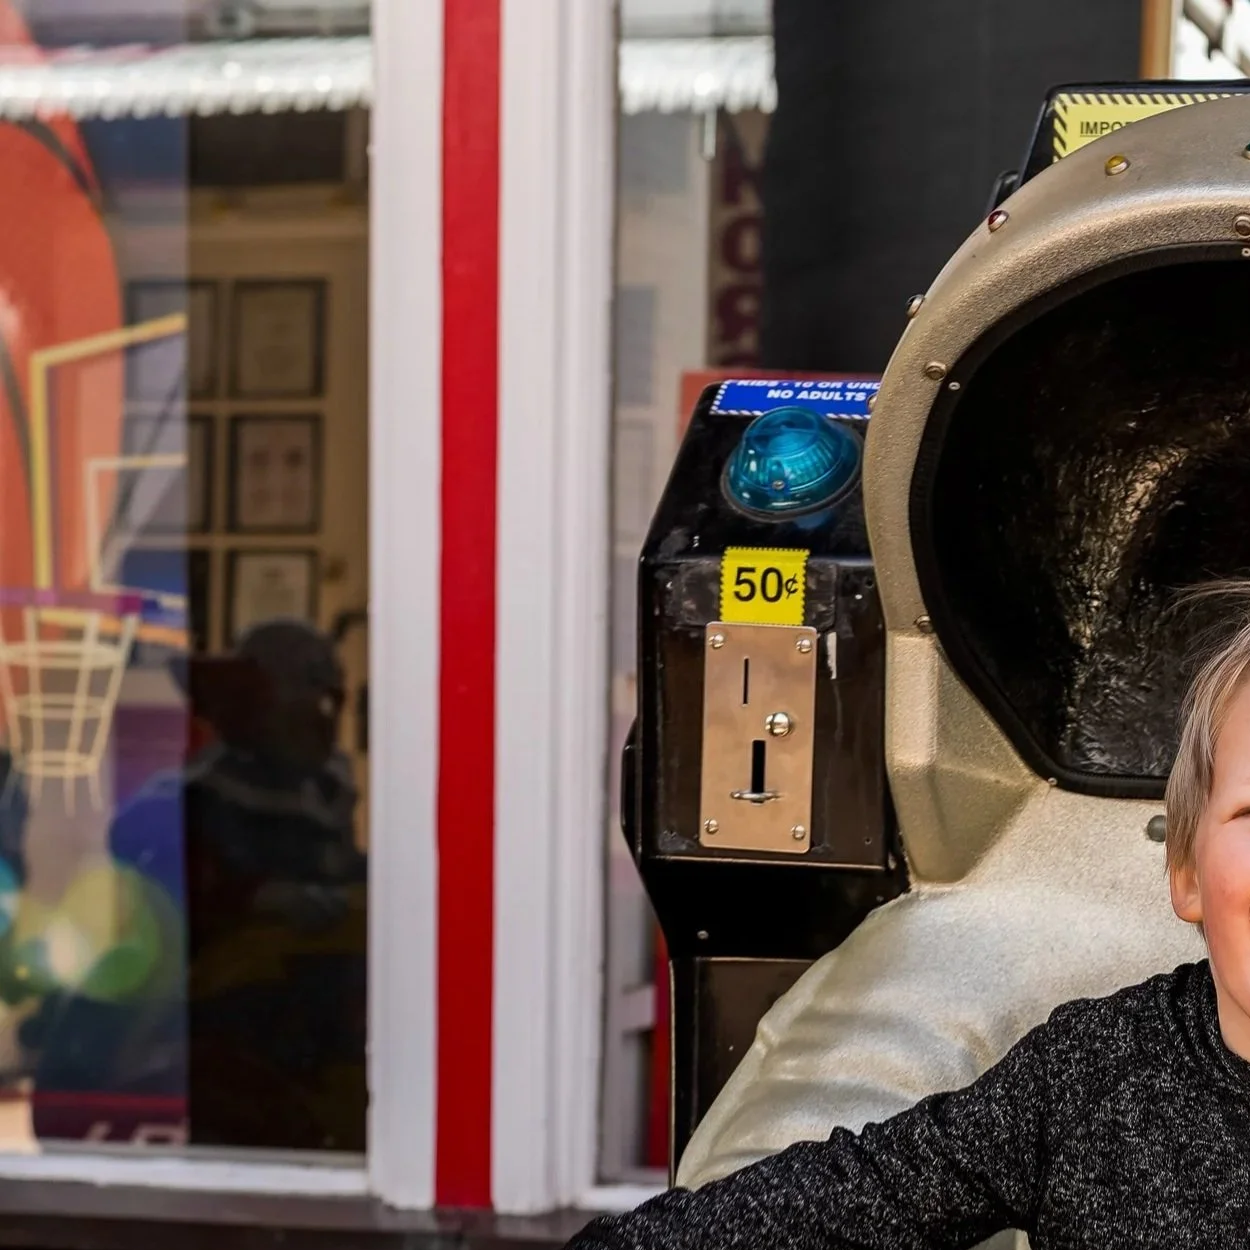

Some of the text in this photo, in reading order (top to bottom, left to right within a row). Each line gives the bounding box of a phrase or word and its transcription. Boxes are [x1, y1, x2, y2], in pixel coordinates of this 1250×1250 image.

[1079, 121, 1133, 135] IMPO
[767, 390, 867, 401] NO ADULTS
[733, 566, 799, 603] 50¢
